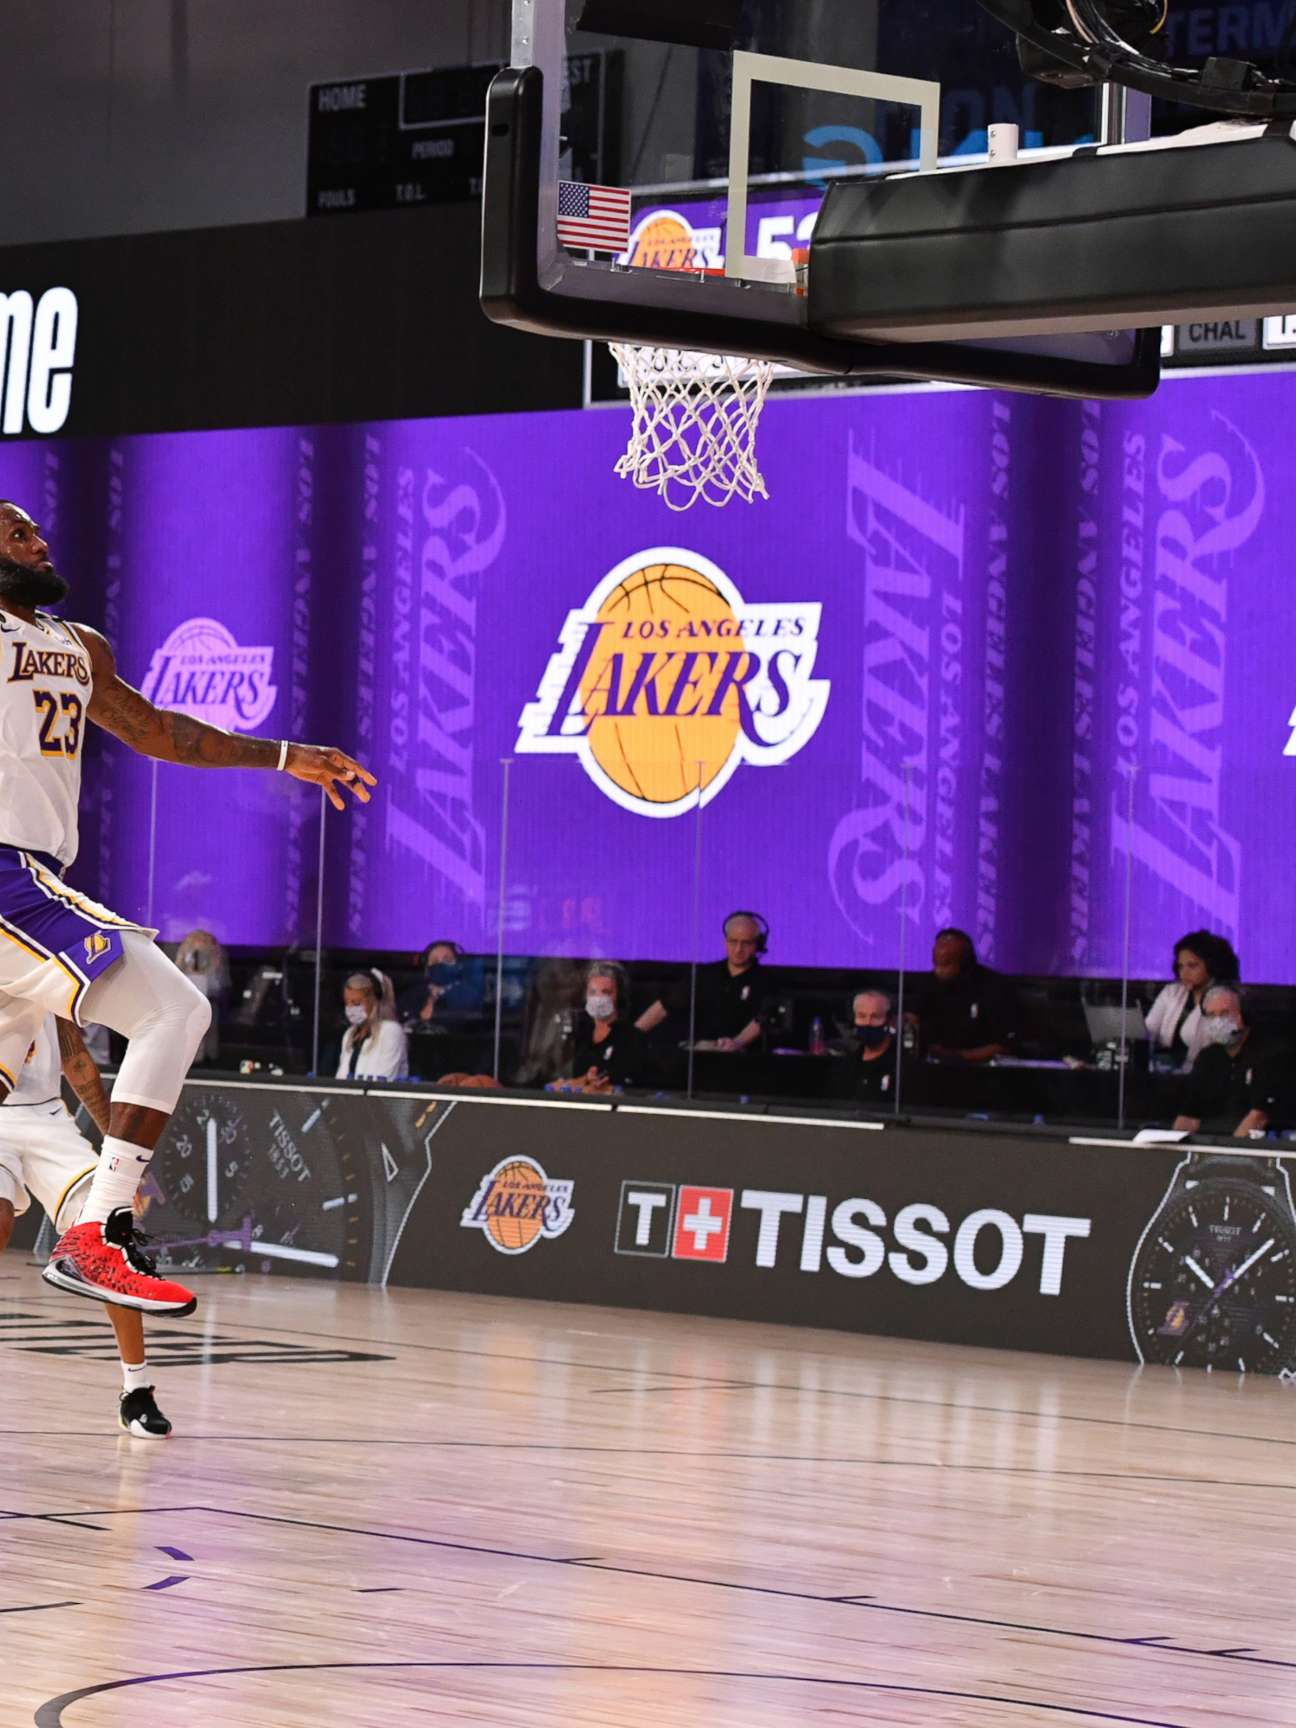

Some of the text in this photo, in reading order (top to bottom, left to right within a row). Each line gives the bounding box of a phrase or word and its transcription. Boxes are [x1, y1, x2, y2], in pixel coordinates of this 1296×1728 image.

[318, 85, 367, 112] HOME
[1189, 320, 1247, 342] CHAL
[388, 465, 415, 775] LOS ANGELES
[622, 616, 806, 639] LOS ANGELES
[1116, 429, 1146, 781] LOS ANGELES
[7, 642, 90, 687] LAKERS
[151, 655, 266, 721] LAKERS
[385, 446, 506, 930] LAKERS
[532, 621, 805, 748] LAKERS
[828, 427, 966, 945] LAKERS
[1110, 409, 1266, 953] LAKERS
[32, 688, 82, 760] 23
[933, 590, 962, 930] LOS ANGELES
[268, 1107, 312, 1184] TISSOT
[472, 1180, 567, 1232] LAKERS
[627, 1189, 1092, 1296] T TISSOT
